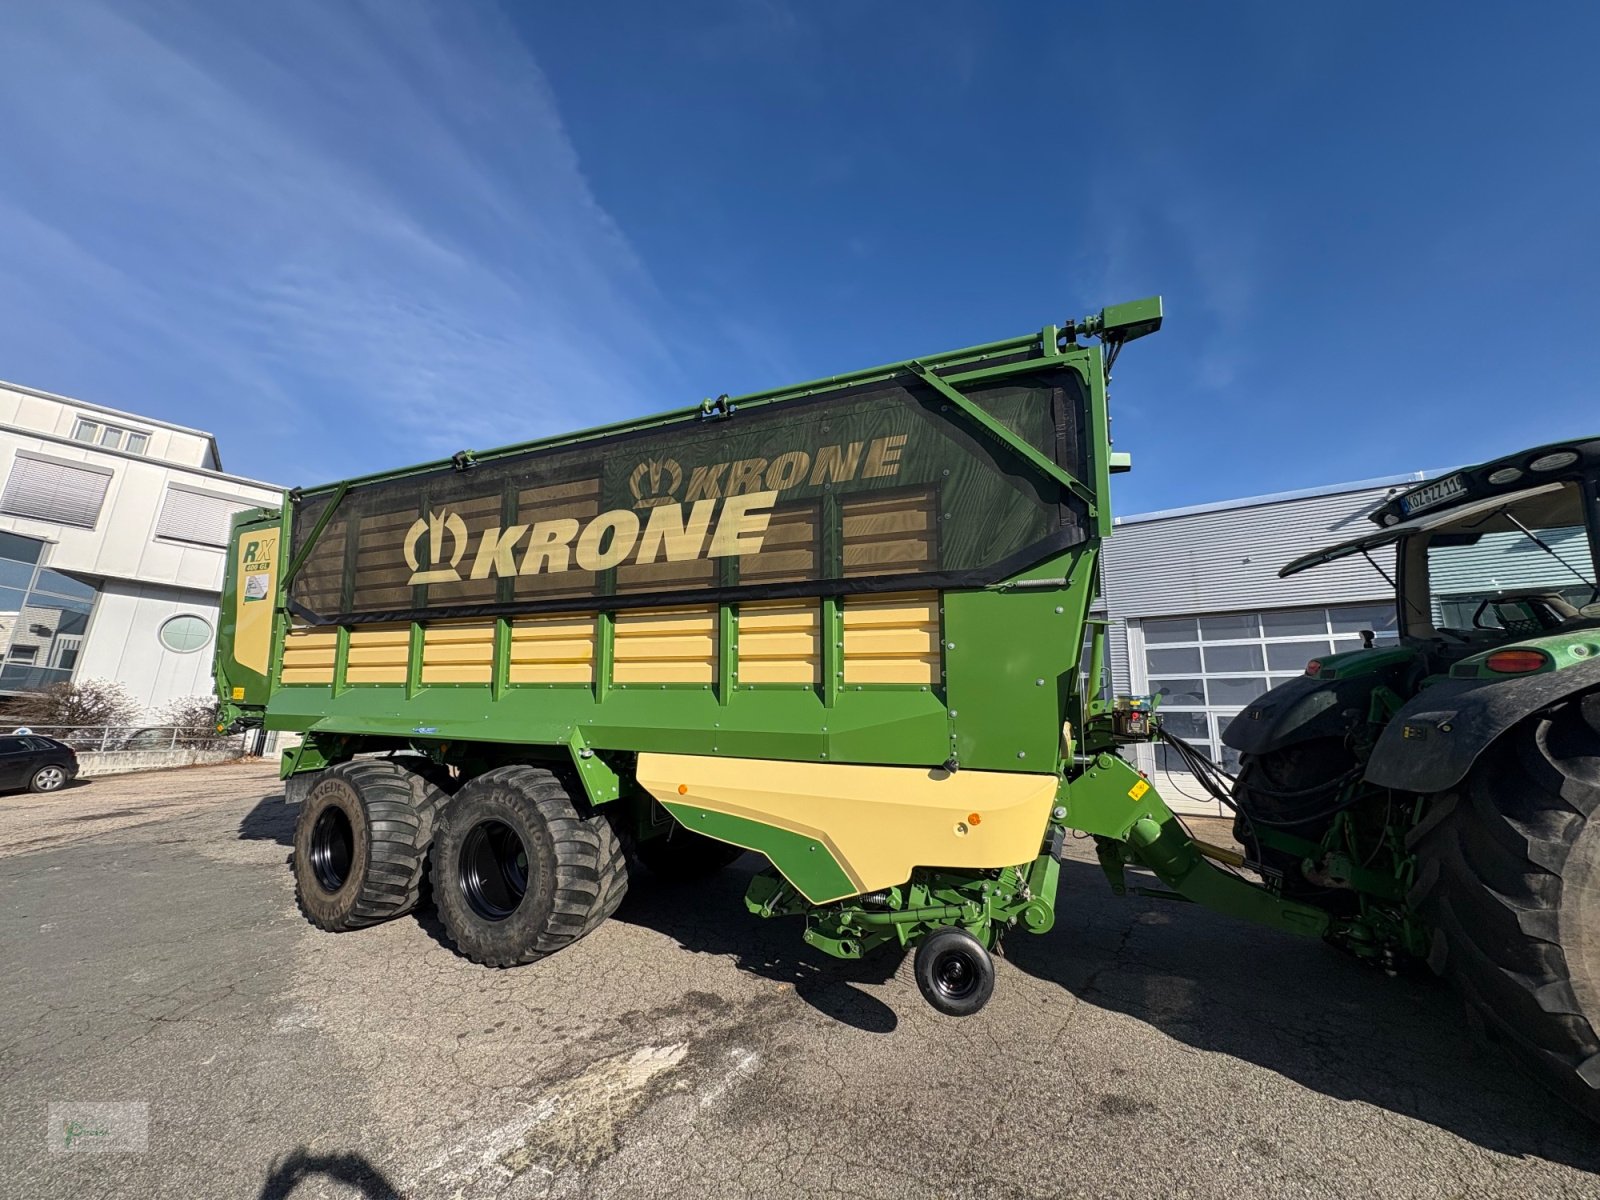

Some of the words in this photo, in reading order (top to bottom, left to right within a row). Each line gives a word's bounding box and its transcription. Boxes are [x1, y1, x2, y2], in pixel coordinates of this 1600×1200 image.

[685, 434, 908, 502] KRONE
[1428, 484, 1444, 501] ZZ
[243, 539, 276, 563] RX
[469, 490, 778, 580] KRONE
